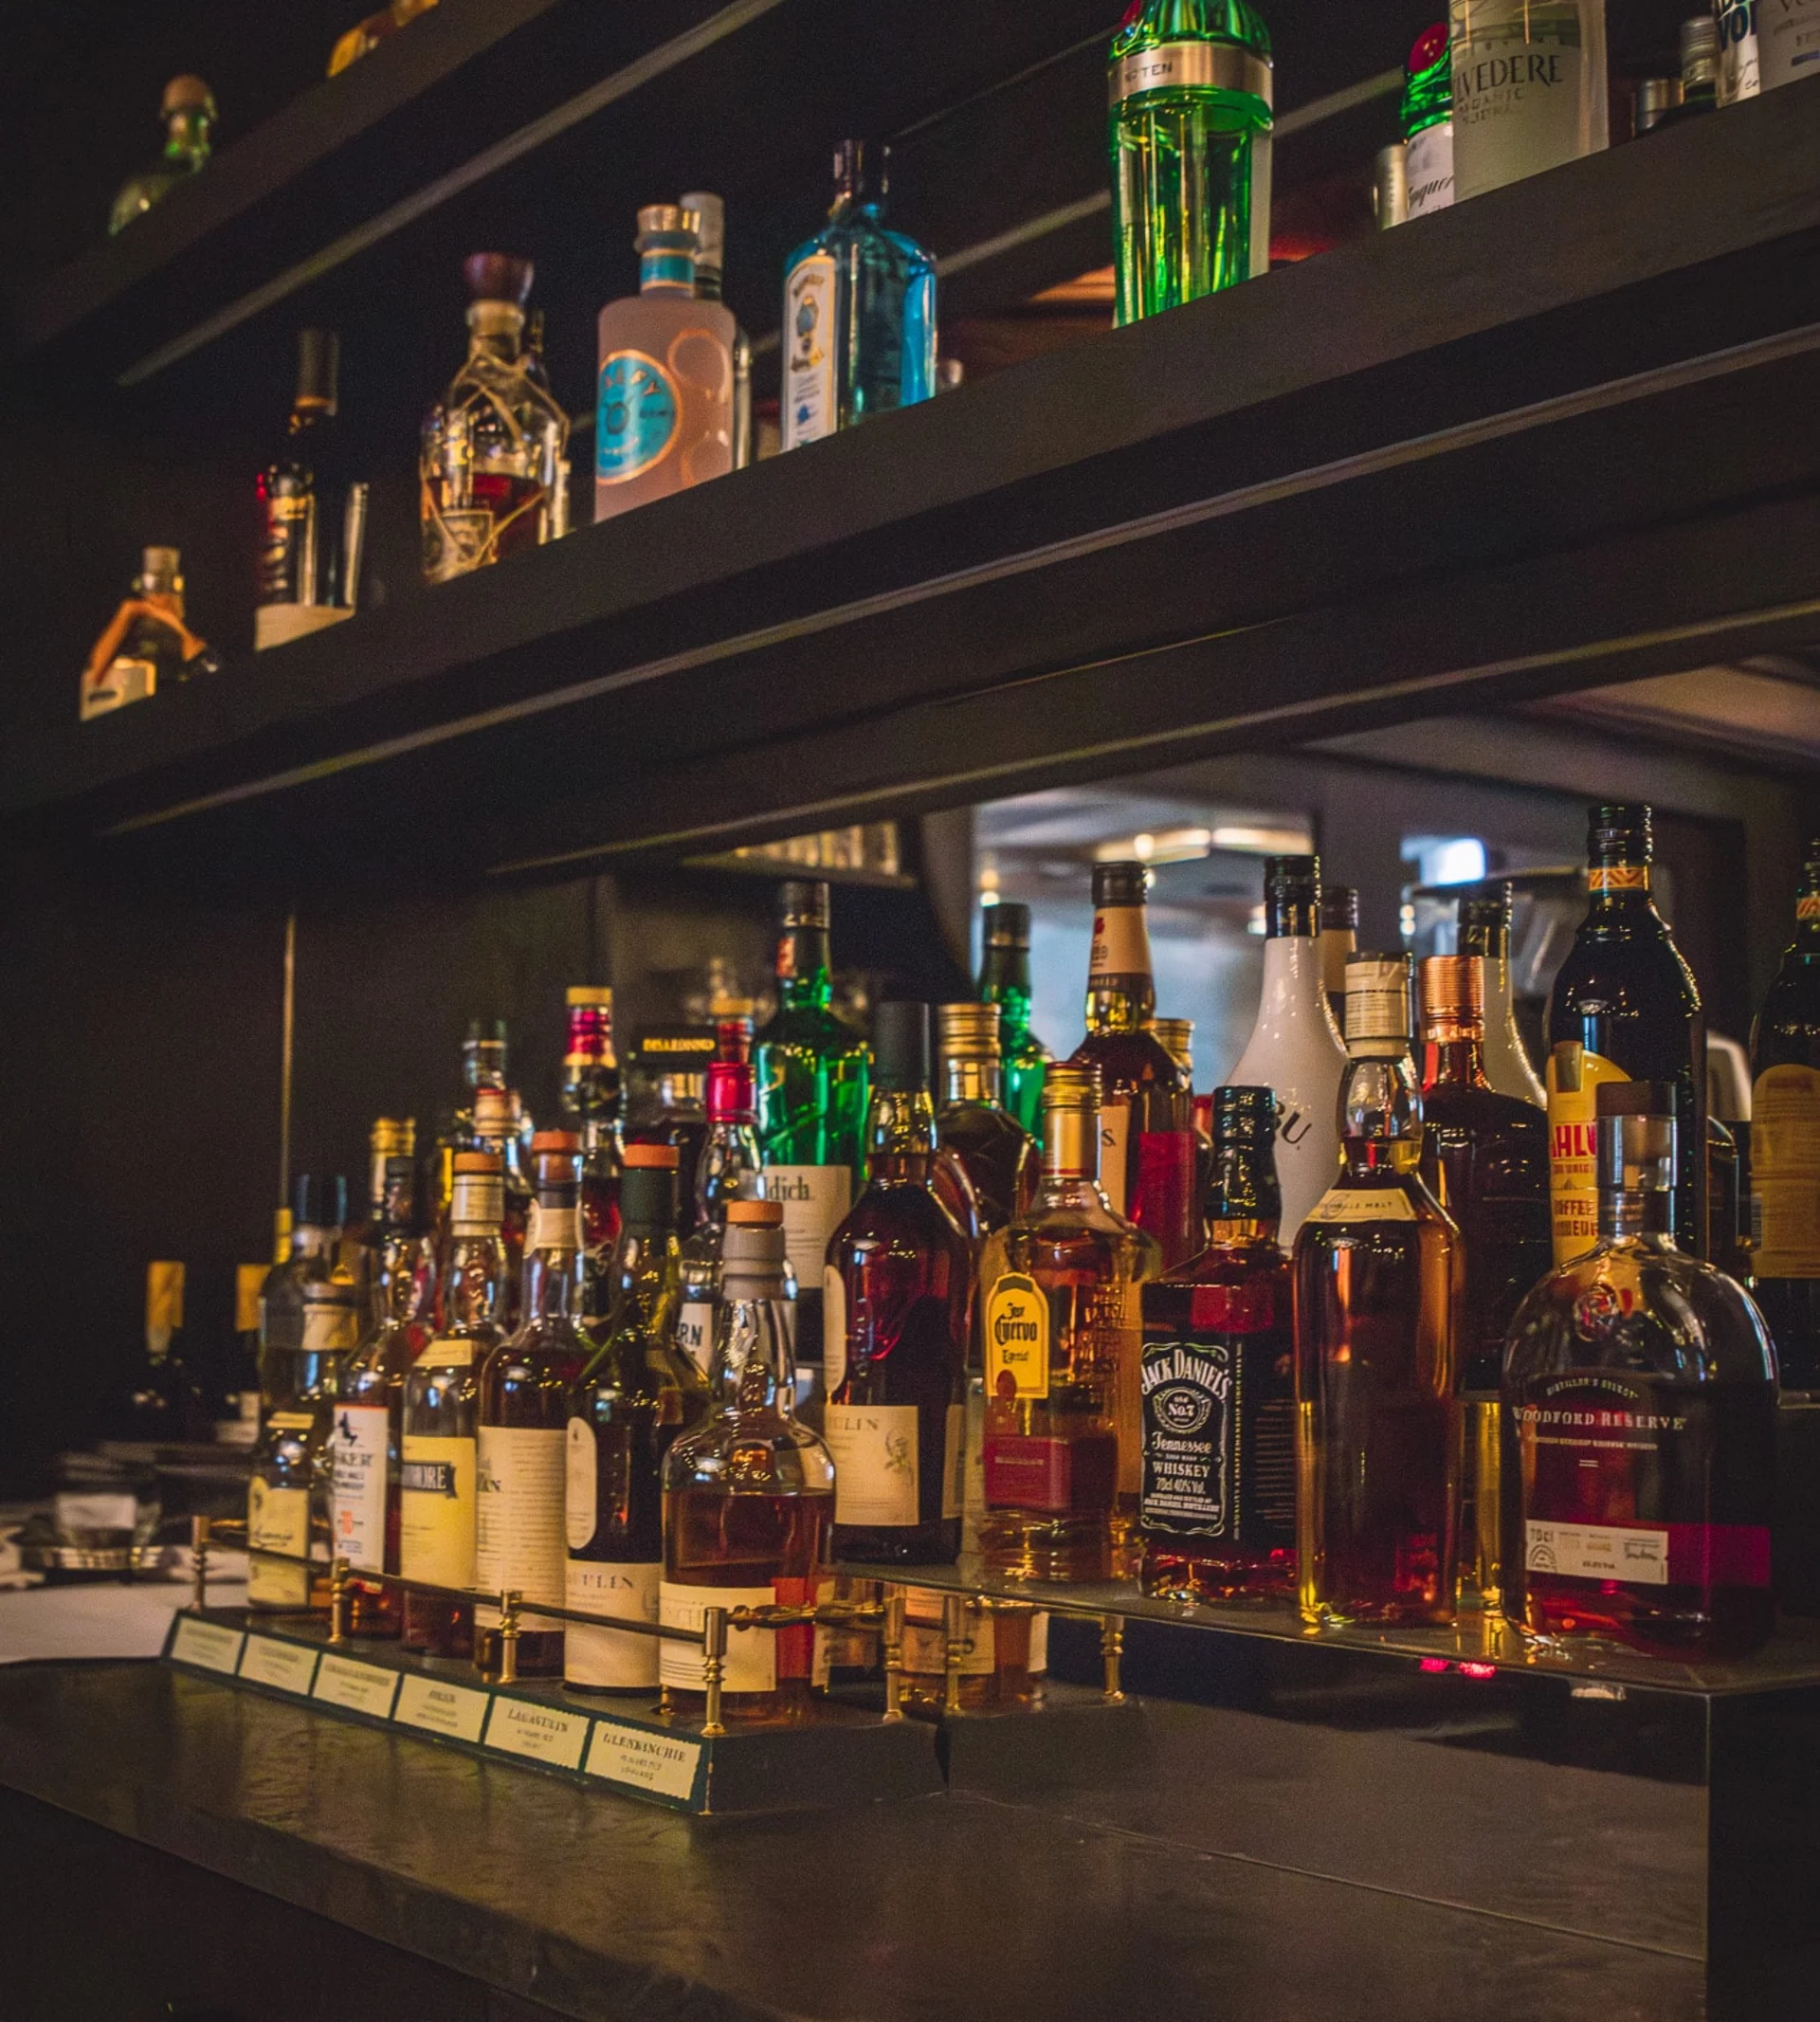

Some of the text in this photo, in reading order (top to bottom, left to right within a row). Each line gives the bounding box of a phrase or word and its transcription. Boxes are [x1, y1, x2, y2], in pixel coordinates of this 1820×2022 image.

[1141, 61, 1173, 79] TEN
[1140, 1348, 1232, 1404] JACK DANIEL'S
[1512, 1406, 1685, 1430] WOODFORD RESERVE
[1151, 1430, 1212, 1454] Tennessee
[1152, 1461, 1211, 1479] WHISKEY
[603, 1732, 686, 1763] GLENKINCHIE
